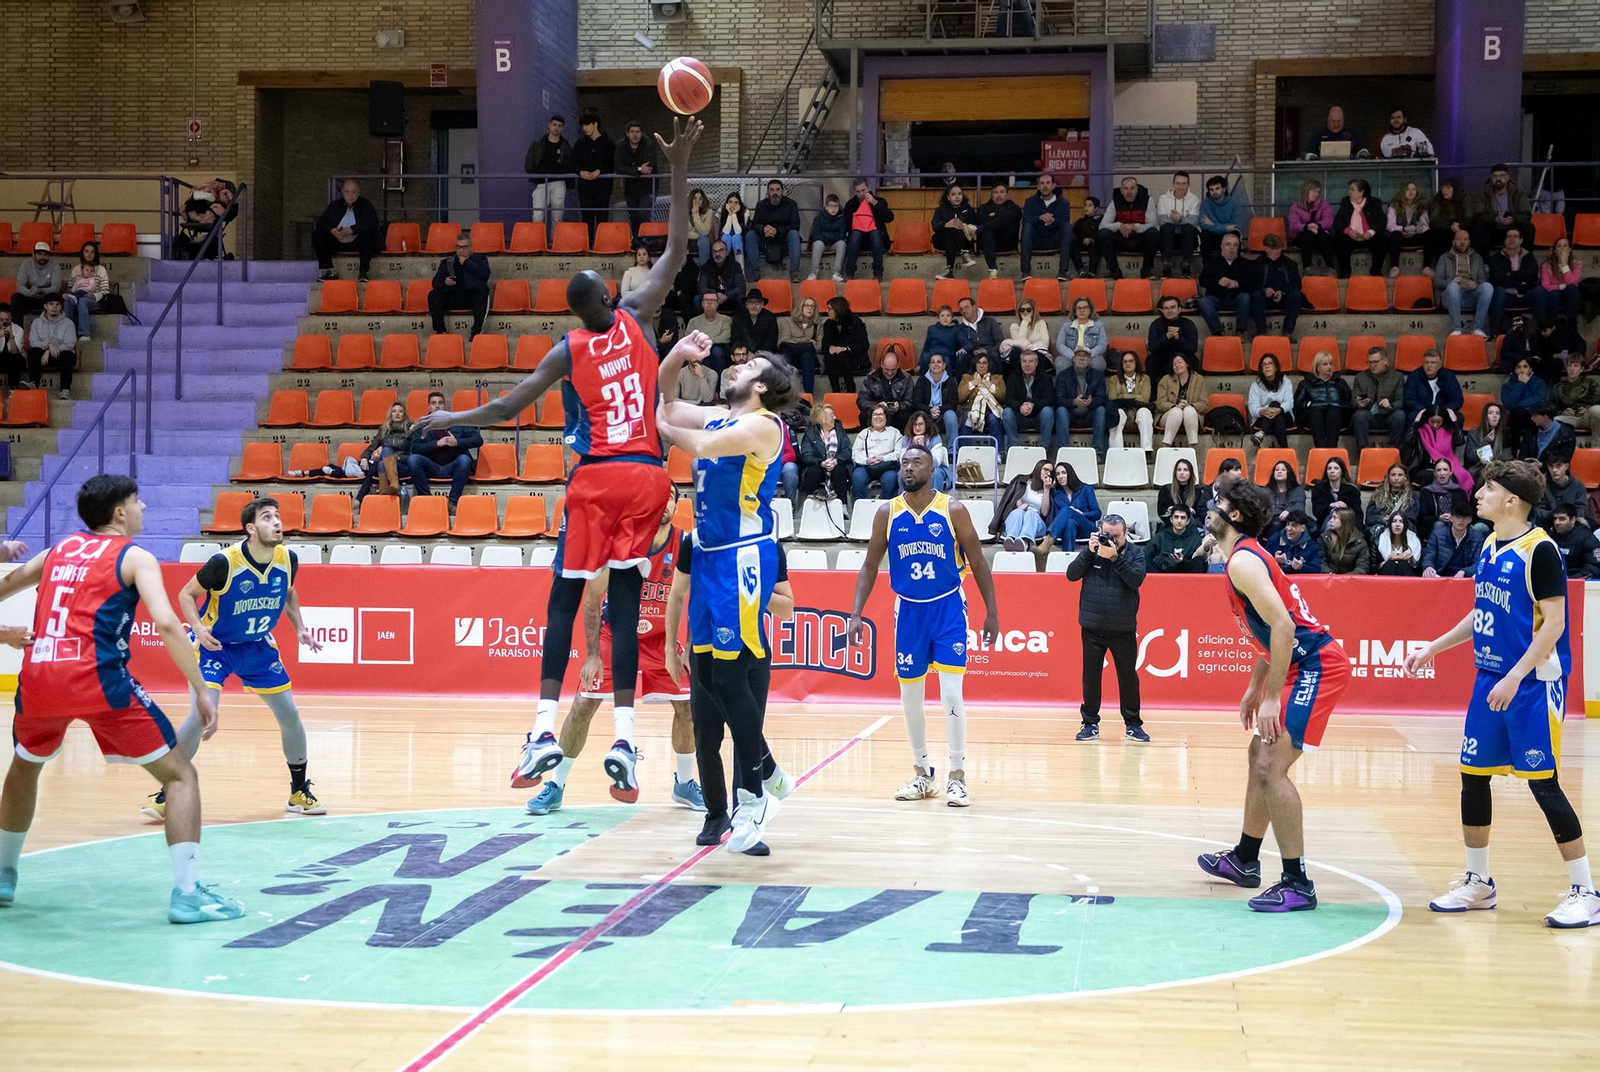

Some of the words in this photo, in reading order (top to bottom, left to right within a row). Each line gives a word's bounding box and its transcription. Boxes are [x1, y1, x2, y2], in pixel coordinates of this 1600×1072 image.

[1484, 35, 1501, 61] B
[496, 48, 512, 72] B
[598, 354, 632, 380] MAYOT
[601, 372, 645, 425] 33
[897, 541, 946, 560] NOVASCHOOL
[910, 561, 936, 581] 34
[46, 585, 75, 638] 5
[245, 615, 271, 635] 12
[1473, 608, 1495, 637] 82
[141, 638, 167, 648] fisiote
[377, 631, 396, 641] JAÉN
[1197, 634, 1234, 646] oficina
[488, 647, 531, 658] PARAÍSO
[897, 652, 914, 666] 34
[1197, 648, 1253, 661] servicios
[990, 669, 1028, 678] comunicación
[1373, 667, 1437, 680] CENER
